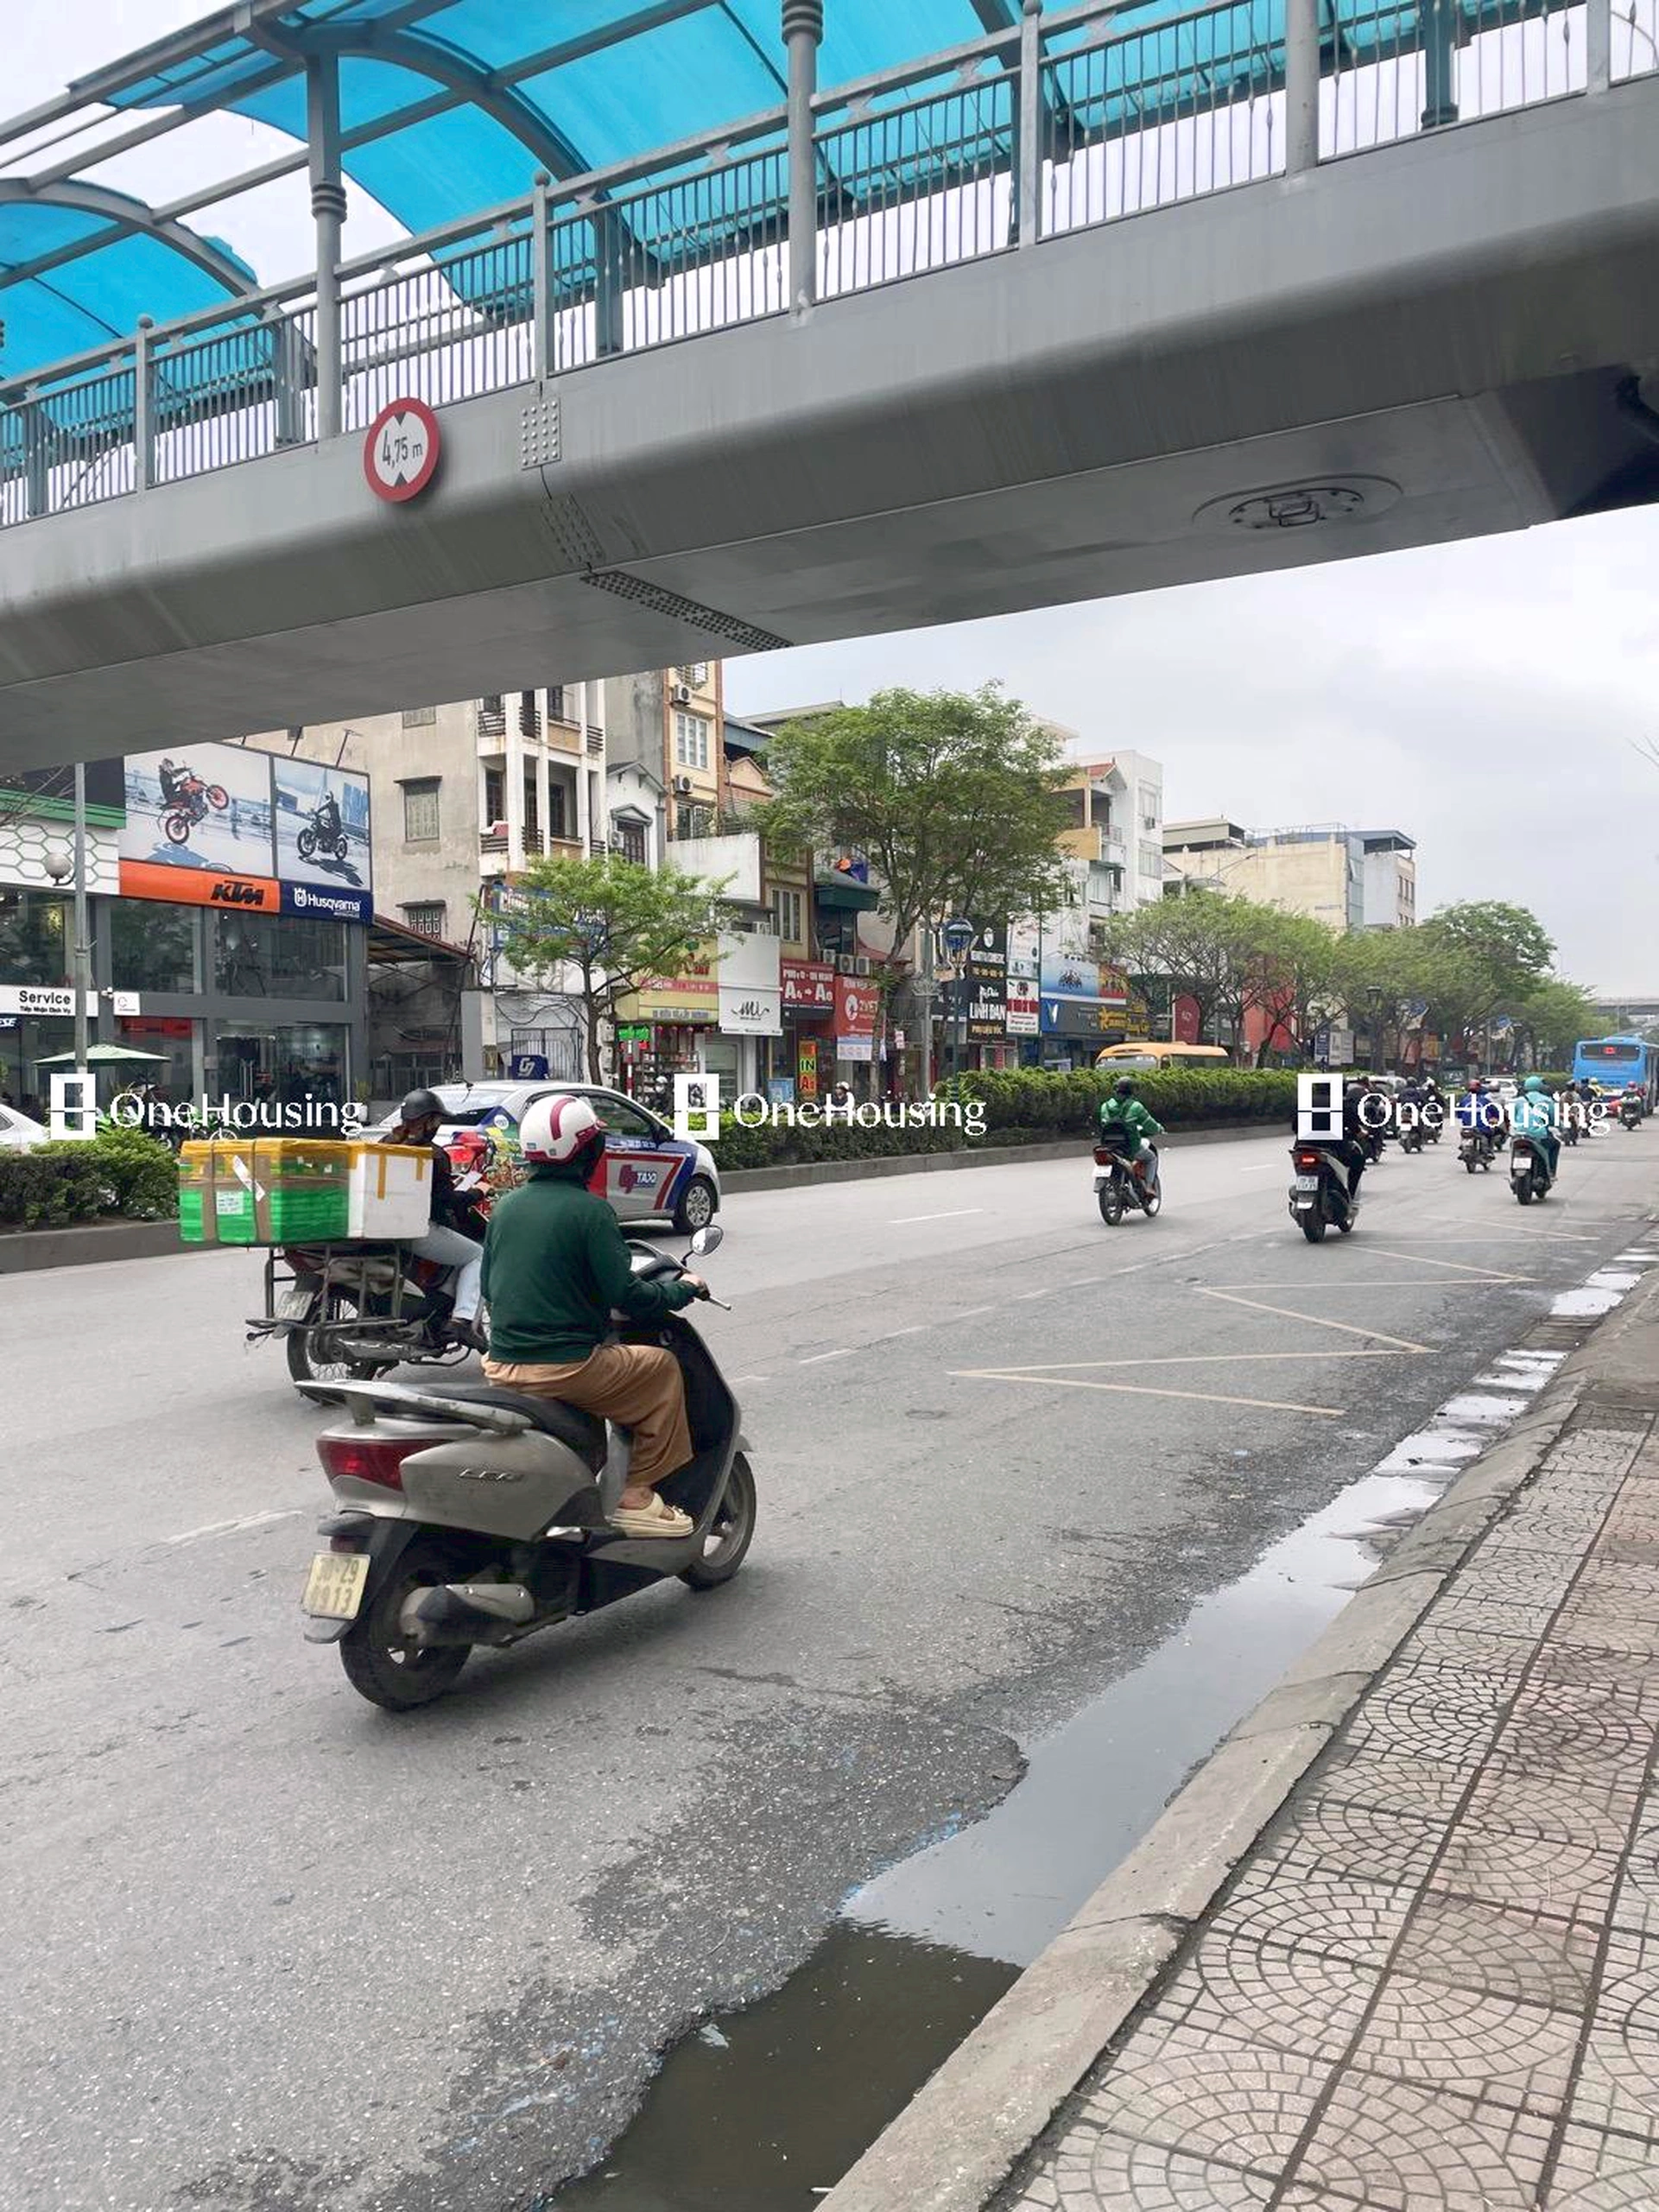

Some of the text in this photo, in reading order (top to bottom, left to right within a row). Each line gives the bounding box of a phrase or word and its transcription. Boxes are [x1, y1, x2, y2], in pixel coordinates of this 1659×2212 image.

[382, 429, 423, 468] 4,75 m
[210, 879, 264, 906] KTM
[307, 892, 361, 912] Husqvarna
[19, 990, 71, 1005] Service
